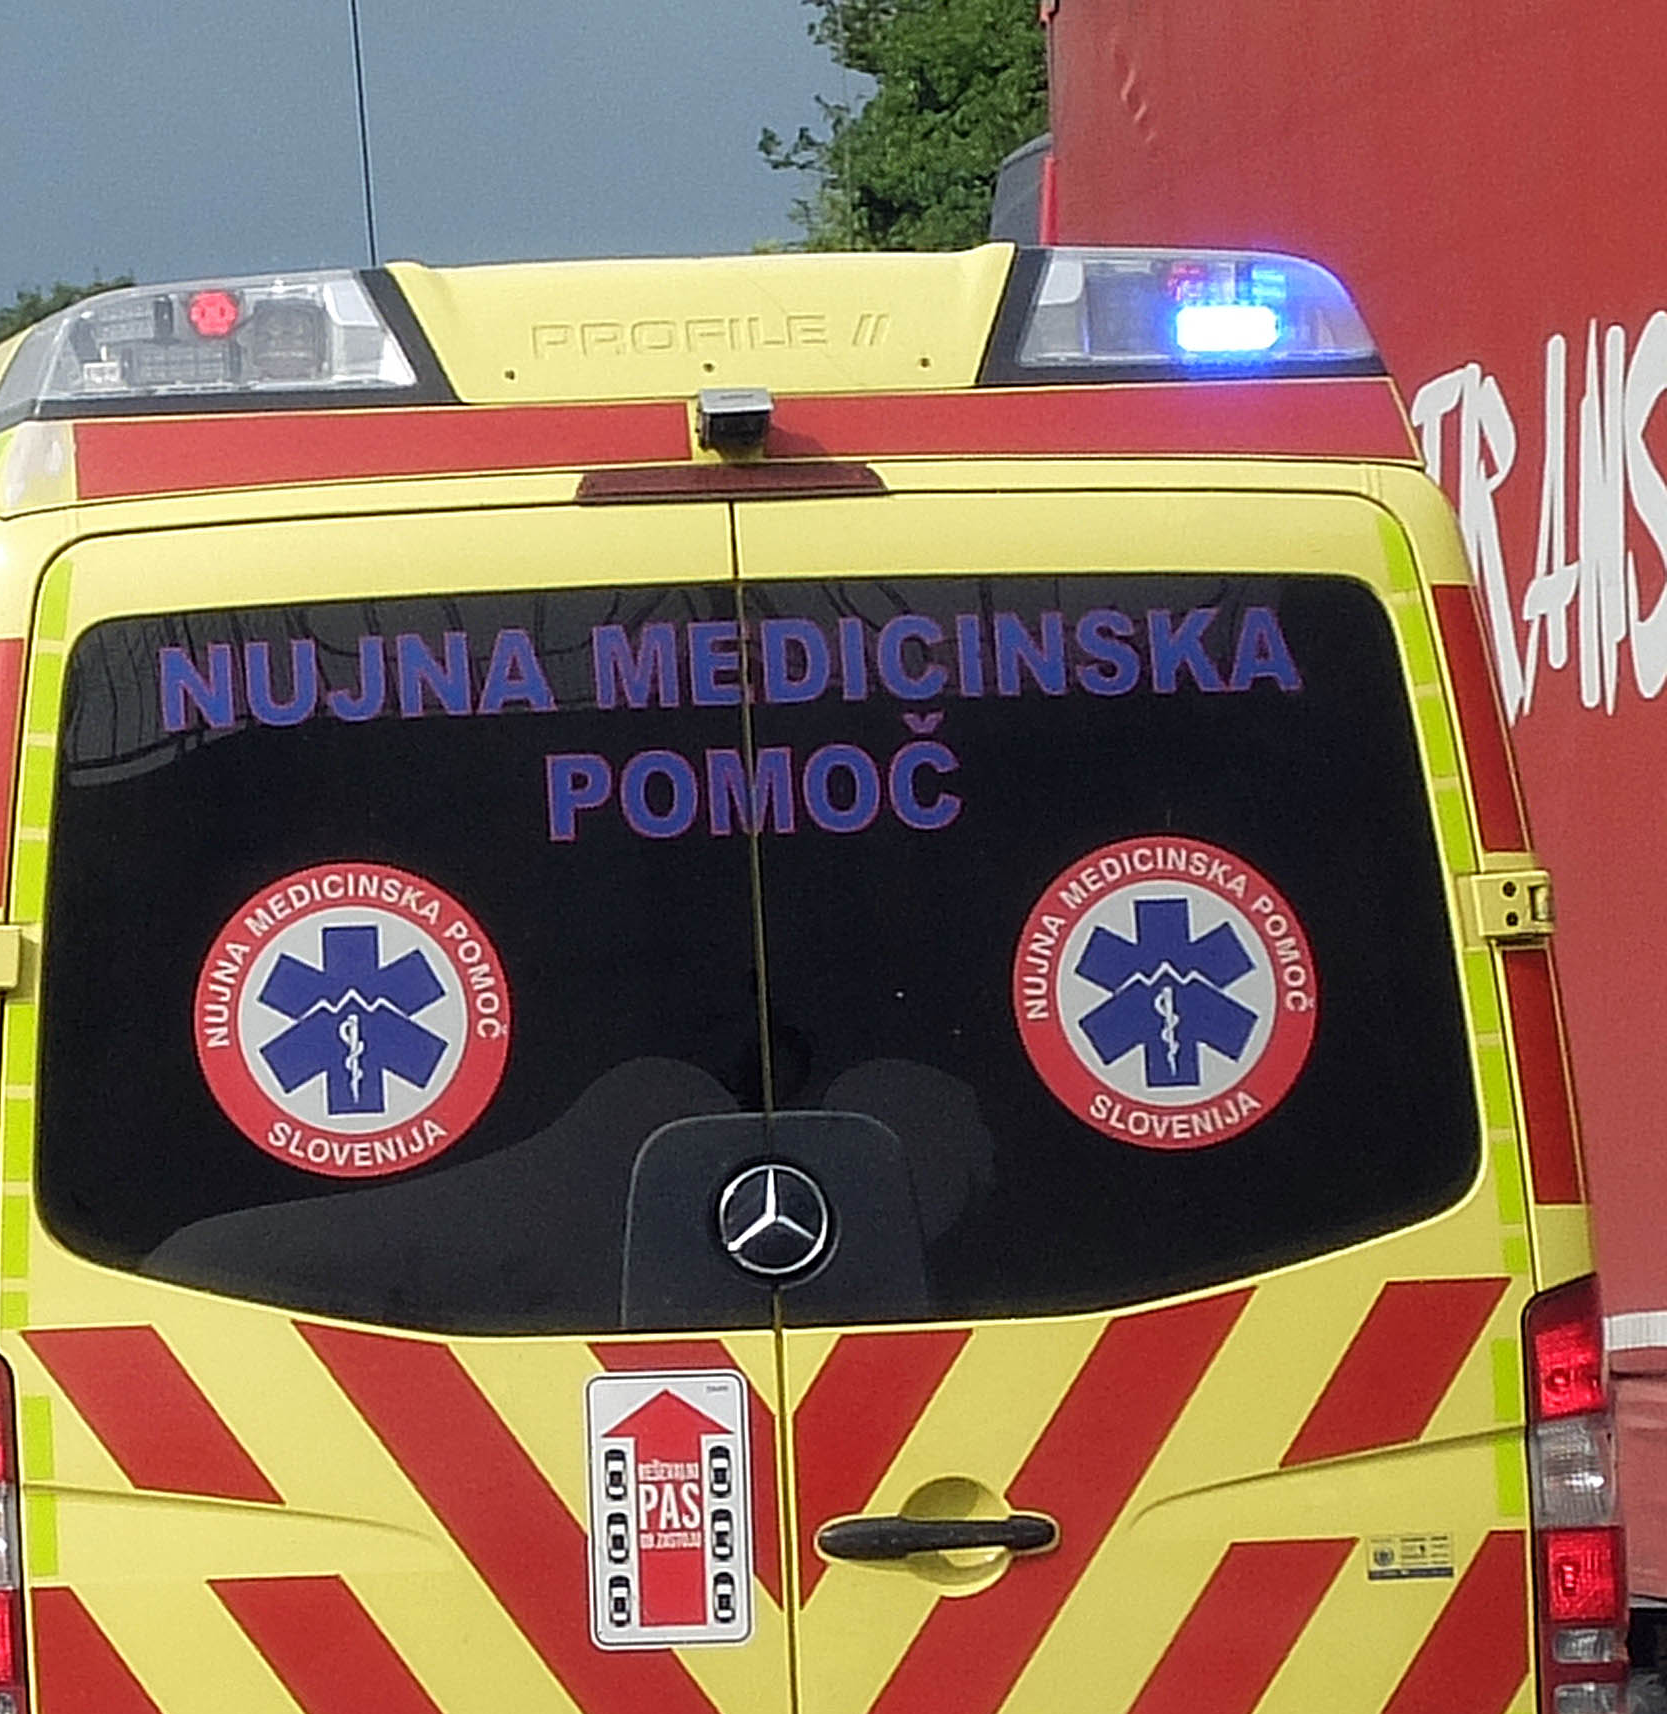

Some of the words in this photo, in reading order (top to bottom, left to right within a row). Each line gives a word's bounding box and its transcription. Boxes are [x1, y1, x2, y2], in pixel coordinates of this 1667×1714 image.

[531, 314, 828, 357] PROFILE
[158, 627, 558, 733] NUJNA
[591, 606, 1303, 710] MEDICINSKA
[547, 711, 962, 842] POMOČ
[203, 941, 251, 1048] NUJNA
[243, 872, 442, 938] MEDICINSKA
[443, 920, 508, 1040] POMOČ
[1022, 912, 1067, 1021] NUJNA
[1058, 846, 1249, 910] MEDICINSKA
[1250, 895, 1315, 1013] POMOČ
[267, 1117, 449, 1167] SLOVENIJA
[1088, 1090, 1263, 1139] SLOVENIJA
[638, 1482, 701, 1530] PAS
